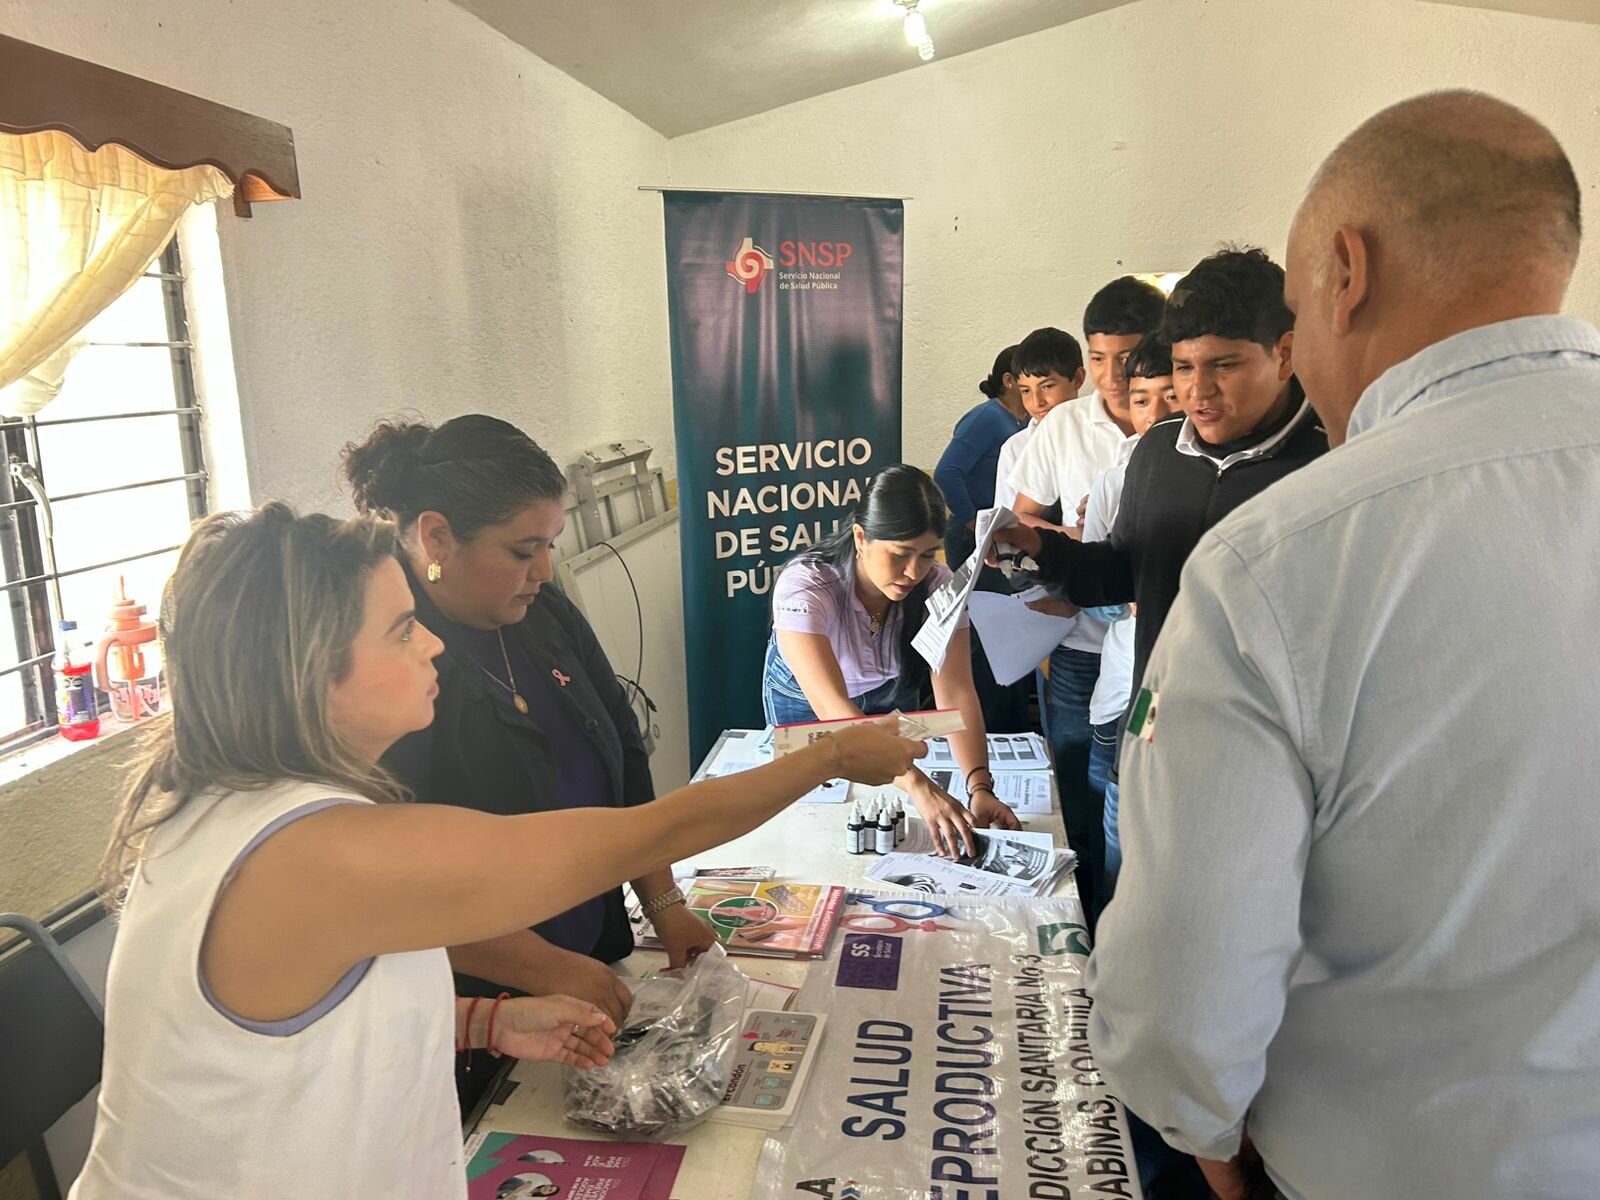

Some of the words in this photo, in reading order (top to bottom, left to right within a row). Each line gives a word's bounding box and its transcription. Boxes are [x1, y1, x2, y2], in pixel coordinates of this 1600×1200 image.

[779, 239, 853, 268] SNSP
[779, 271, 807, 280] Servicio
[809, 271, 841, 280] Nacional
[779, 282, 789, 290] de
[791, 282, 810, 290] Salud
[812, 280, 838, 290] Pública
[715, 437, 872, 477] SERVICIO
[706, 476, 871, 519] NACIONA
[715, 527, 761, 559] DE
[851, 943, 871, 958] SS
[1012, 954, 1043, 963] 3
[1013, 966, 1045, 988] No
[1014, 993, 1058, 1093] SANITARIA
[841, 1019, 914, 1141] SALUD
